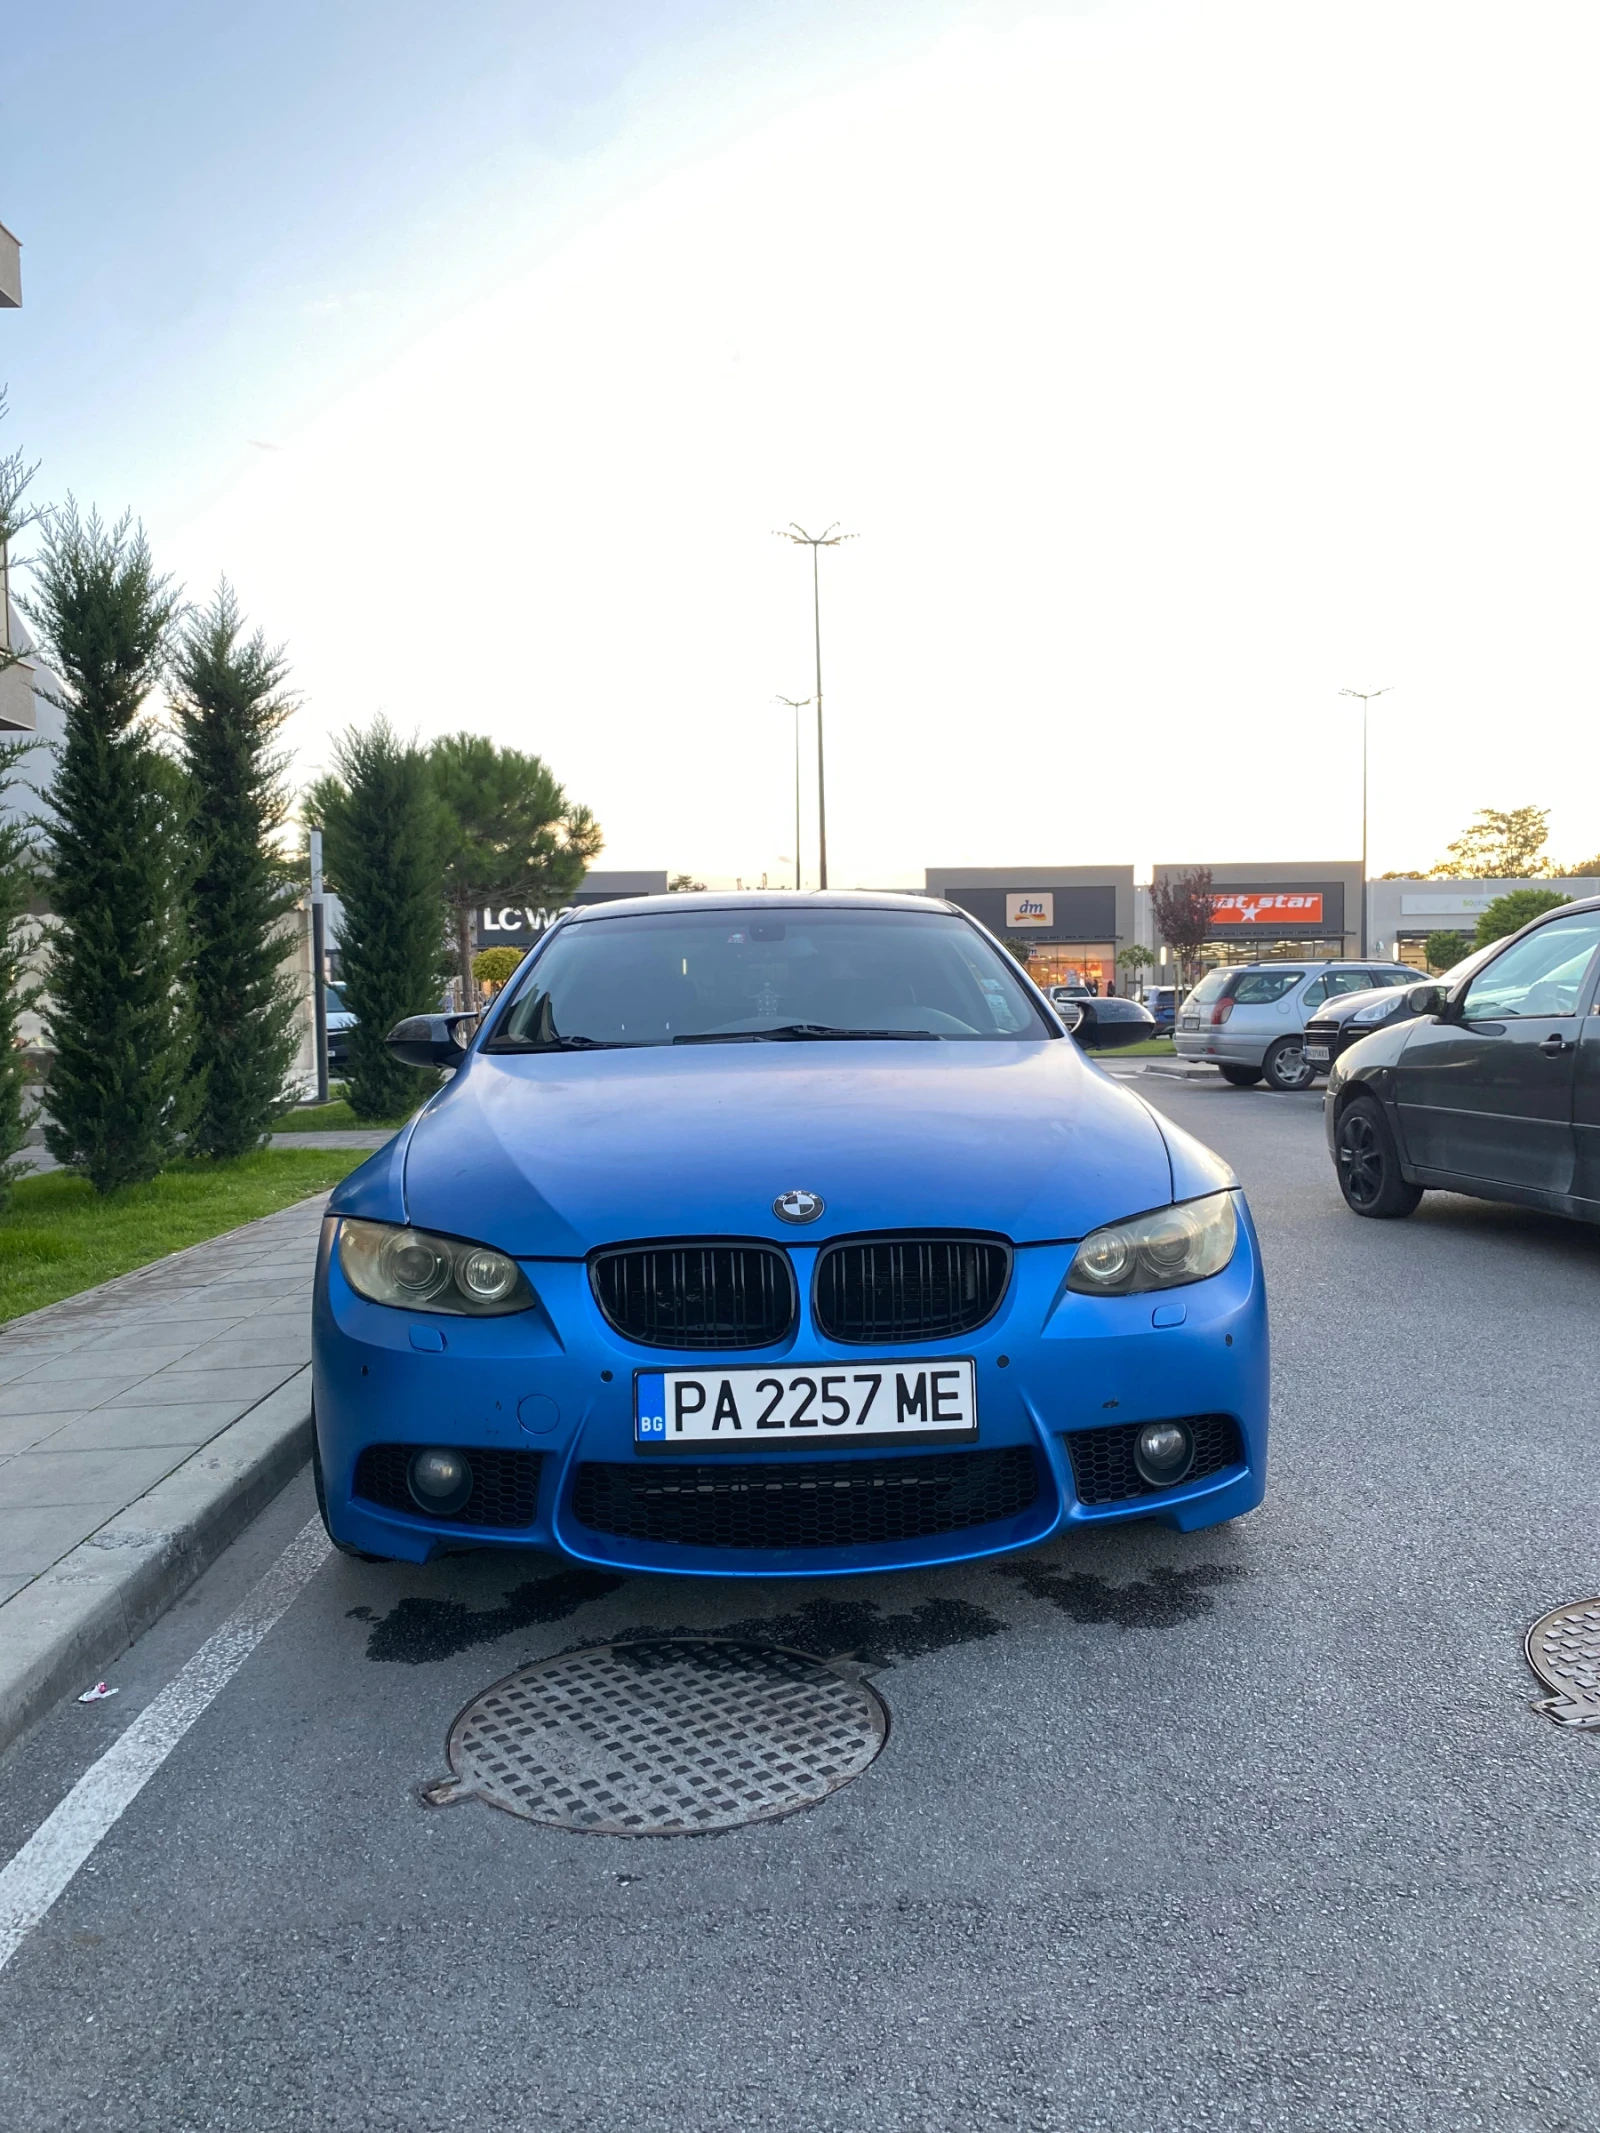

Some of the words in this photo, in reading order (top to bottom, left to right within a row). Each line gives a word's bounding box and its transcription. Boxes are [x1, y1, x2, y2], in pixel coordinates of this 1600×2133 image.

[1019, 899, 1043, 913] dm
[1258, 895, 1319, 908] star
[483, 907, 522, 930] LC
[778, 1190, 818, 1201] BMW
[674, 1379, 742, 1432] PA
[755, 1373, 882, 1430] 2257
[895, 1370, 963, 1423] ME
[641, 1416, 663, 1432] BG
